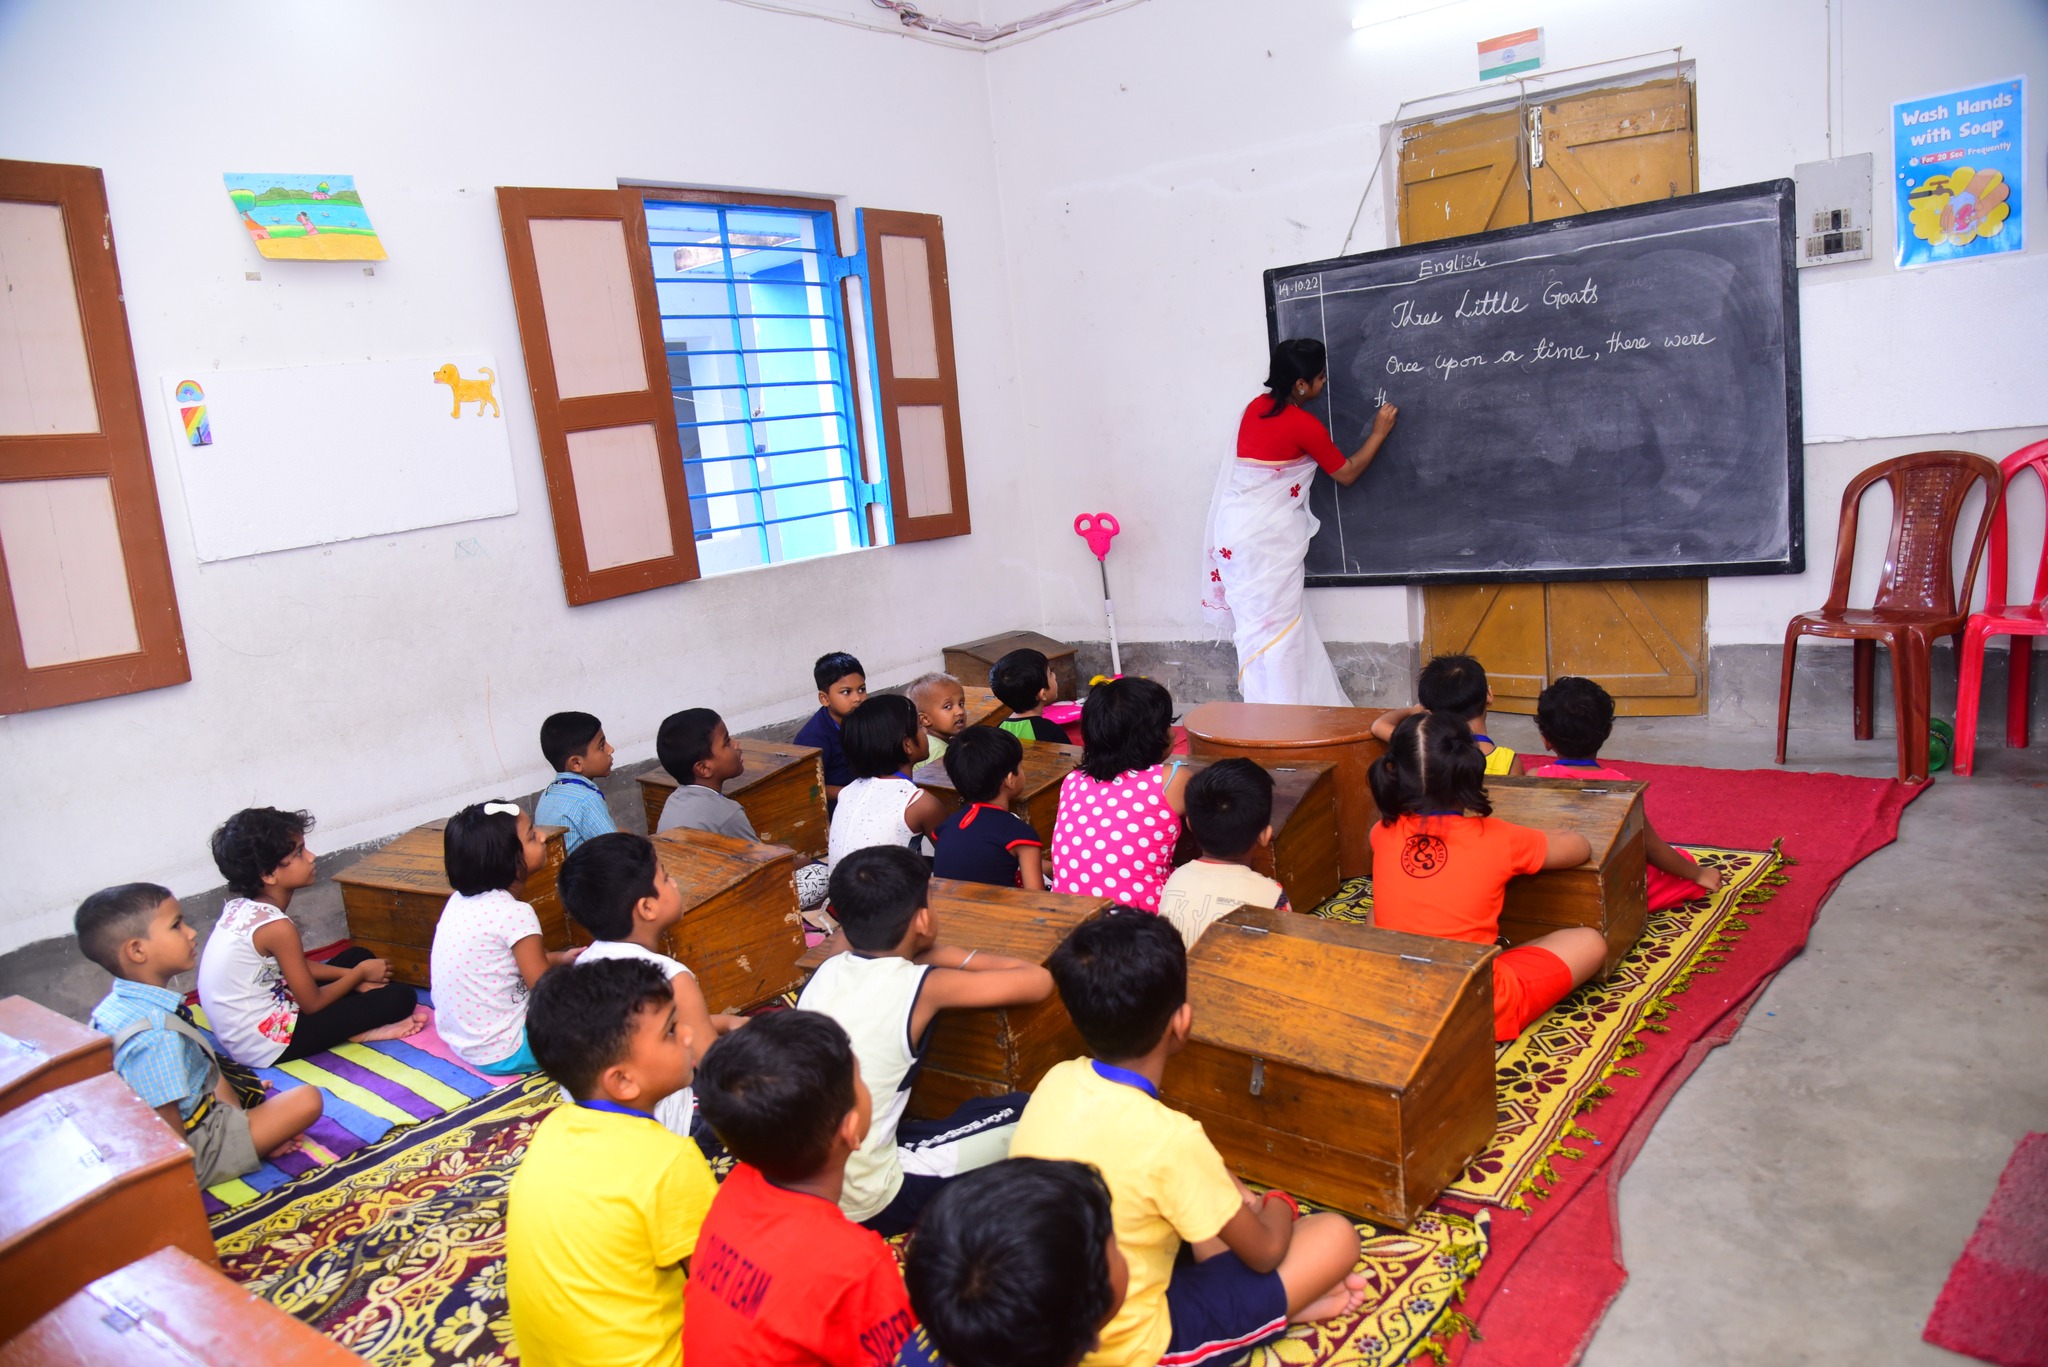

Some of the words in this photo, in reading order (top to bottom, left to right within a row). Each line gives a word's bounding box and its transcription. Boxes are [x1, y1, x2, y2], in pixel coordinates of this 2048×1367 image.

[1902, 105, 1949, 127] Wash
[1956, 93, 2013, 116] Hands
[1910, 127, 1951, 147] with
[1959, 120, 2004, 139] Soap
[1921, 156, 1935, 164] For
[1938, 153, 1947, 161] 20
[1949, 151, 1964, 159] Sec
[1967, 142, 2011, 155] Frequently
[1419, 251, 1487, 278] English
[1391, 300, 1443, 328] Three
[1455, 289, 1529, 318] Little
[1542, 277, 1598, 309] Goats
[1385, 356, 1424, 375] Once
[1434, 353, 1487, 381] upon
[1494, 350, 1524, 364] a
[1530, 338, 1599, 364] time,
[1606, 331, 1651, 354] there
[1664, 332, 1717, 348] were
[725, 1257, 773, 1320] TEAM
